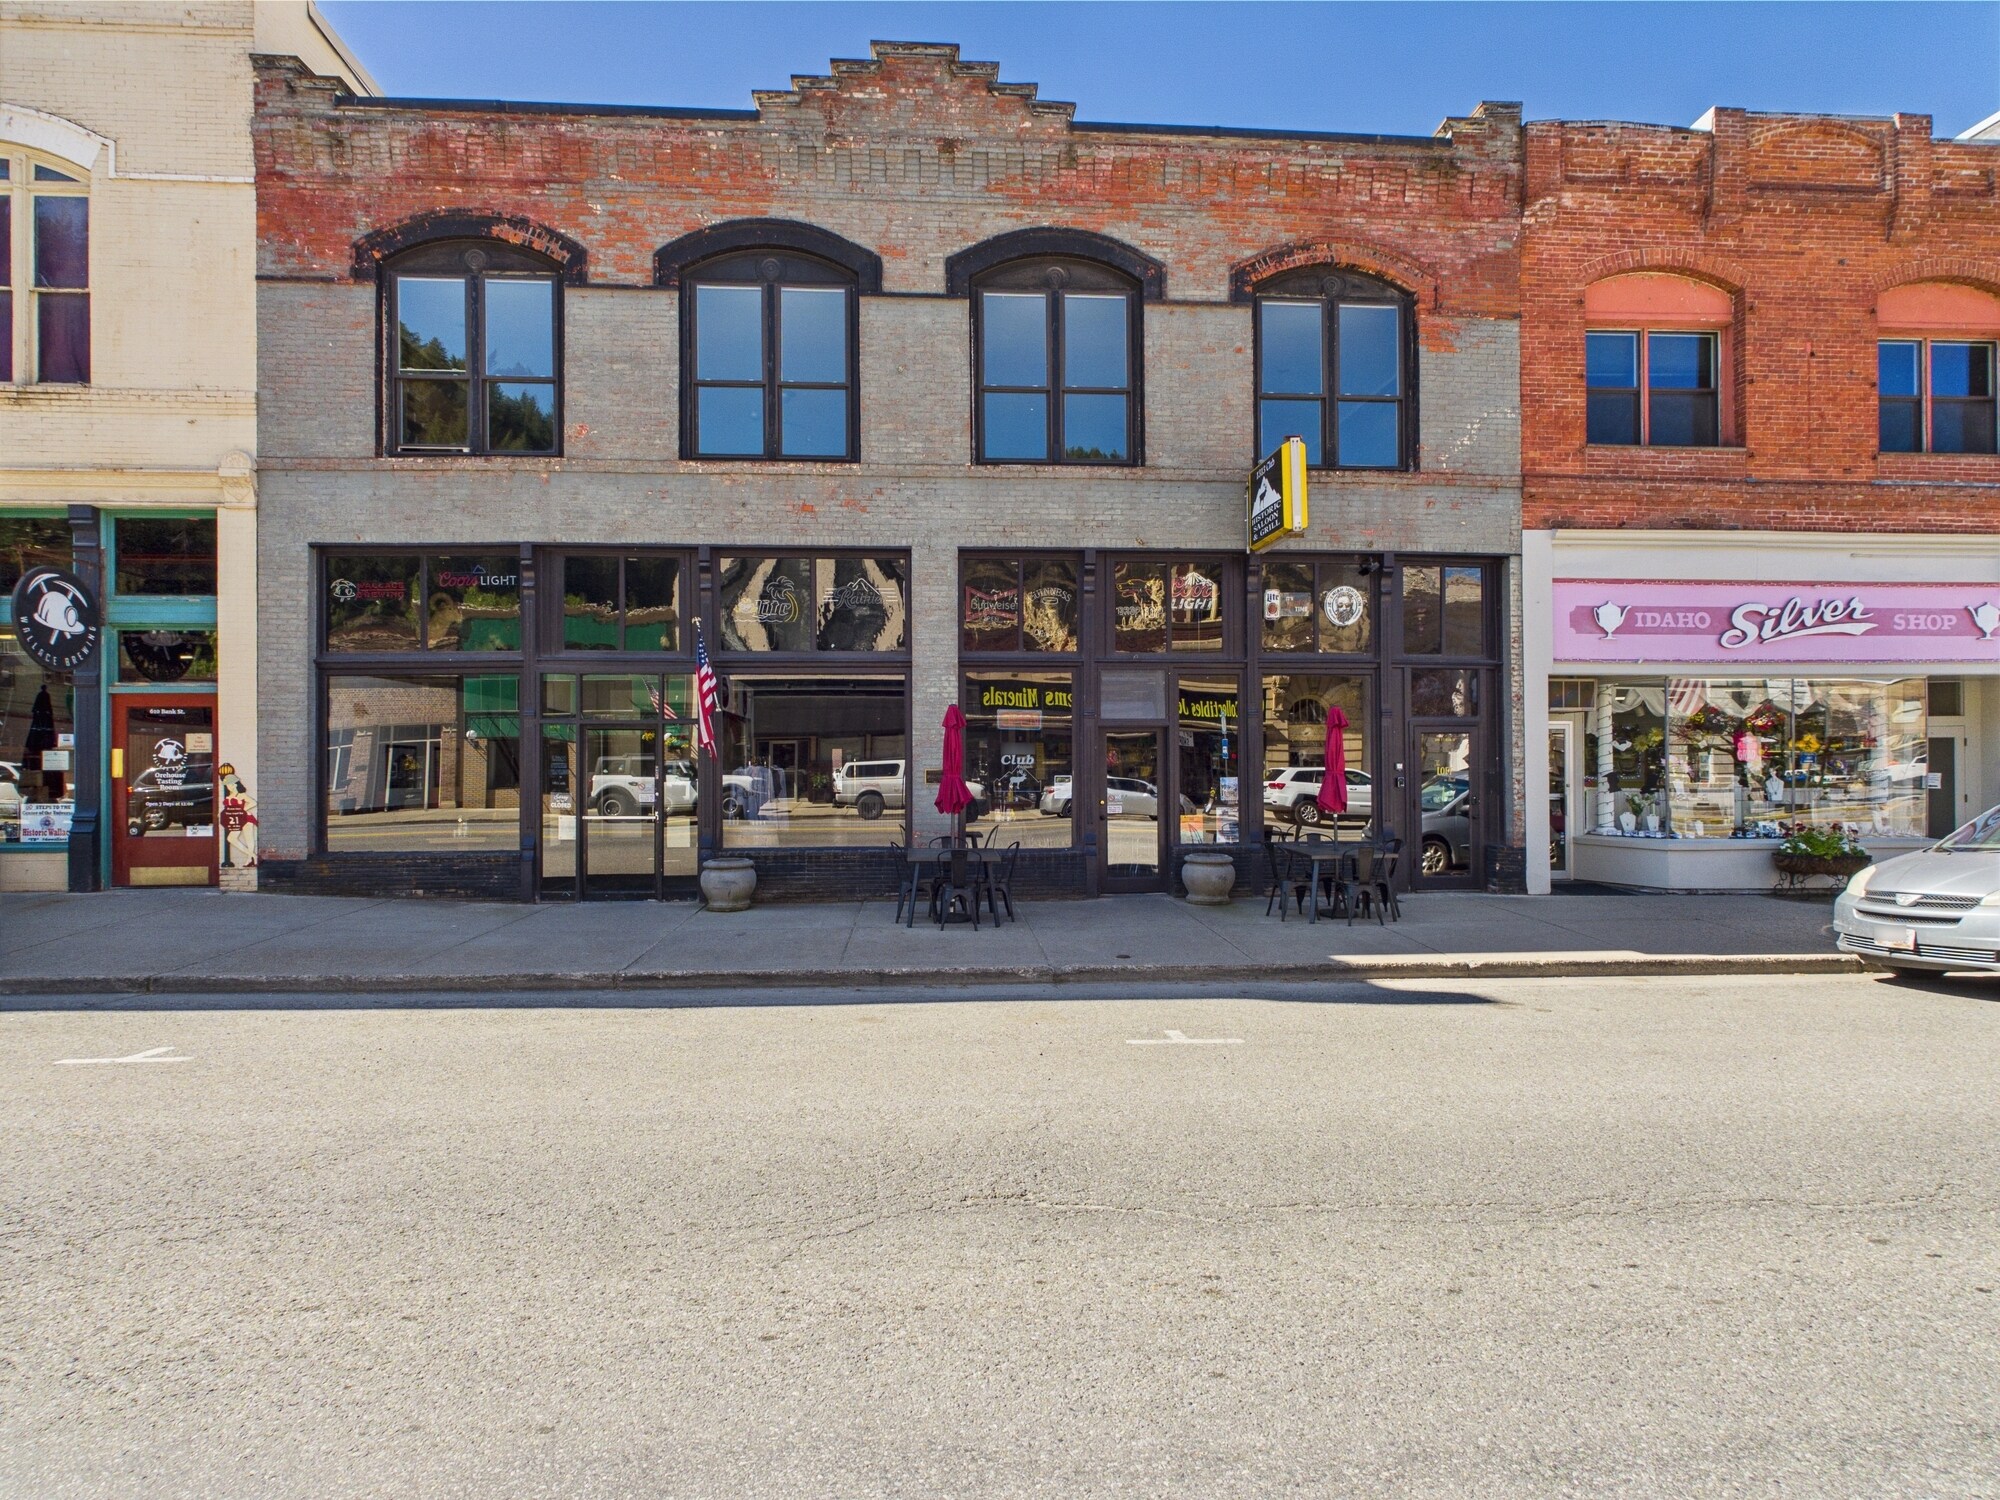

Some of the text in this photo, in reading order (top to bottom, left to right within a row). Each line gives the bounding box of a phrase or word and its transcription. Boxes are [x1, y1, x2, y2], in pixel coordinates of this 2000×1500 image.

[1251, 500, 1282, 527] HISTORIC
[1253, 510, 1279, 533] SALOON
[1252, 519, 1281, 541] & GRILL
[439, 571, 517, 587] Coors LIGHT
[833, 585, 884, 610] Rainie
[1266, 593, 1280, 603] Lite
[1634, 596, 1958, 649] IDAHO Silver SHOP
[20, 615, 97, 667] WALLACE BREWING
[1001, 754, 1035, 765] Club
[228, 816, 239, 825] 21
[22, 828, 47, 837] Historic
